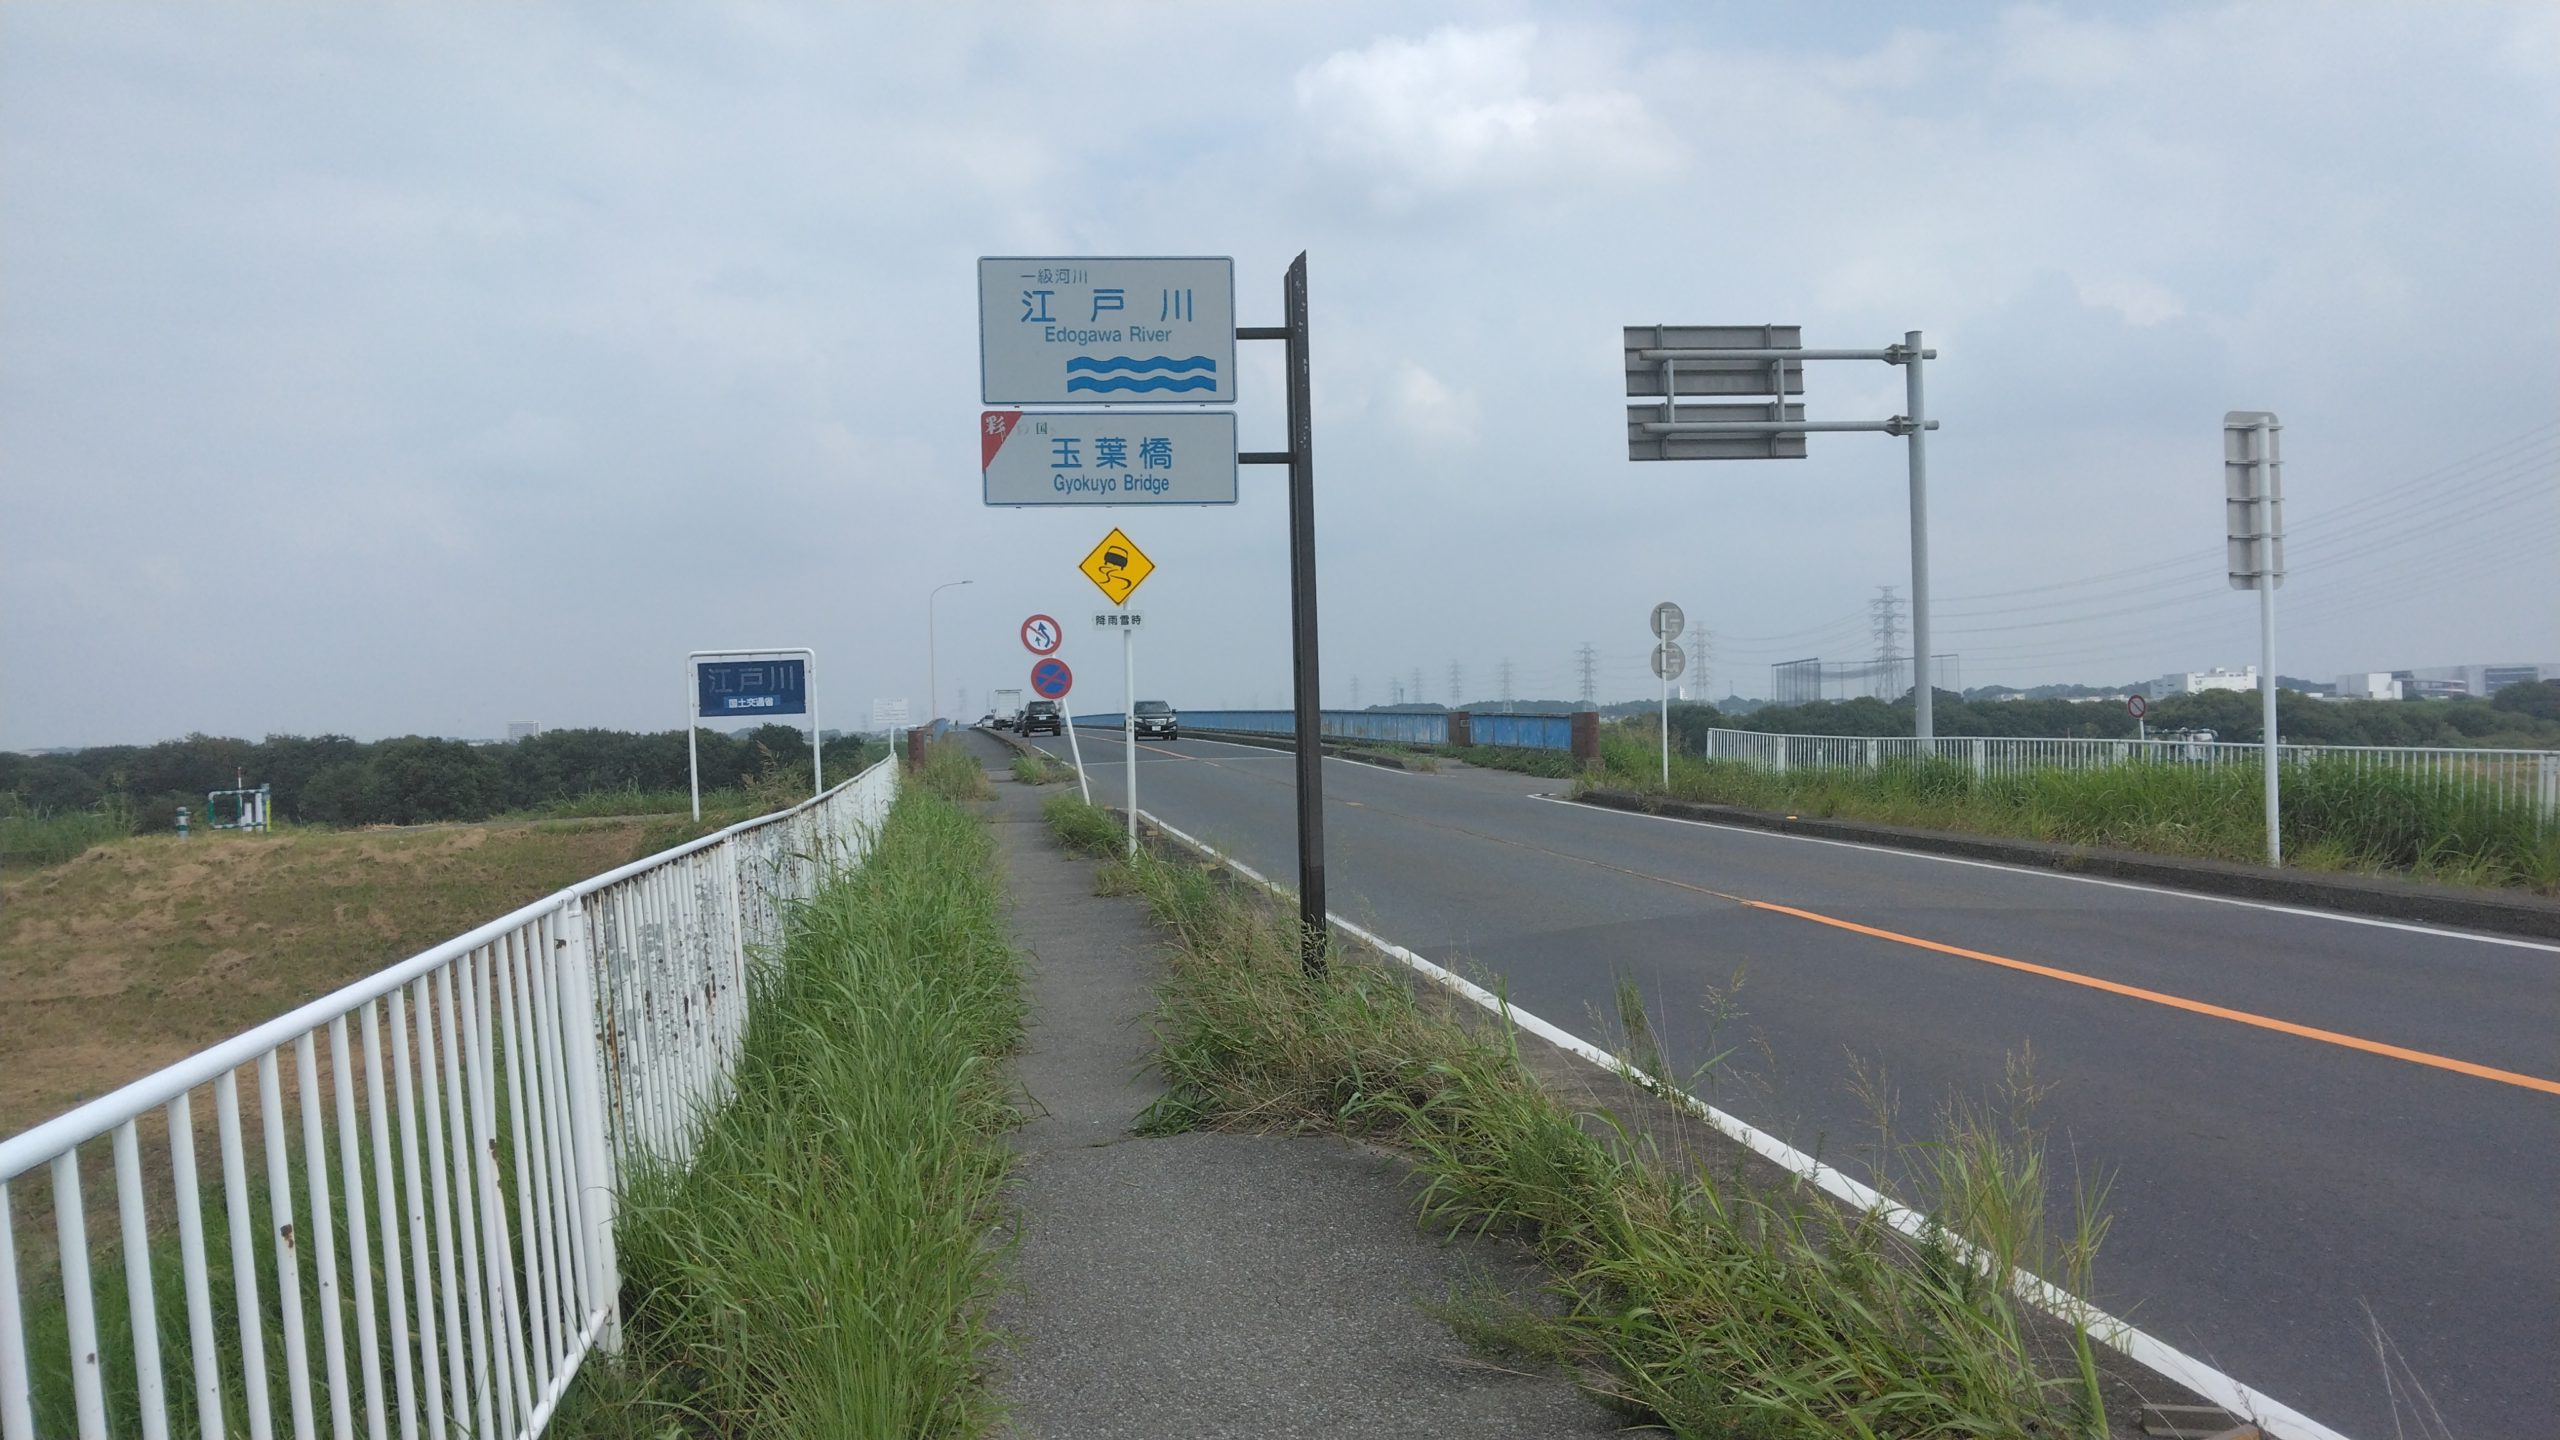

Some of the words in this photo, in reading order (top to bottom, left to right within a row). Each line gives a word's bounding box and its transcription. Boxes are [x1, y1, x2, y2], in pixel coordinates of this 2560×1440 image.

[1020, 269, 1088, 284] 一級河川
[1021, 289, 1193, 323] 江戸川
[1045, 326, 1122, 346] Edogawa
[1130, 325, 1172, 343] River
[1050, 437, 1173, 470] 玉葉橋
[1054, 474, 1116, 495] Gyokuyo
[1124, 474, 1169, 494] Bridge
[708, 665, 795, 693] 江戸川
